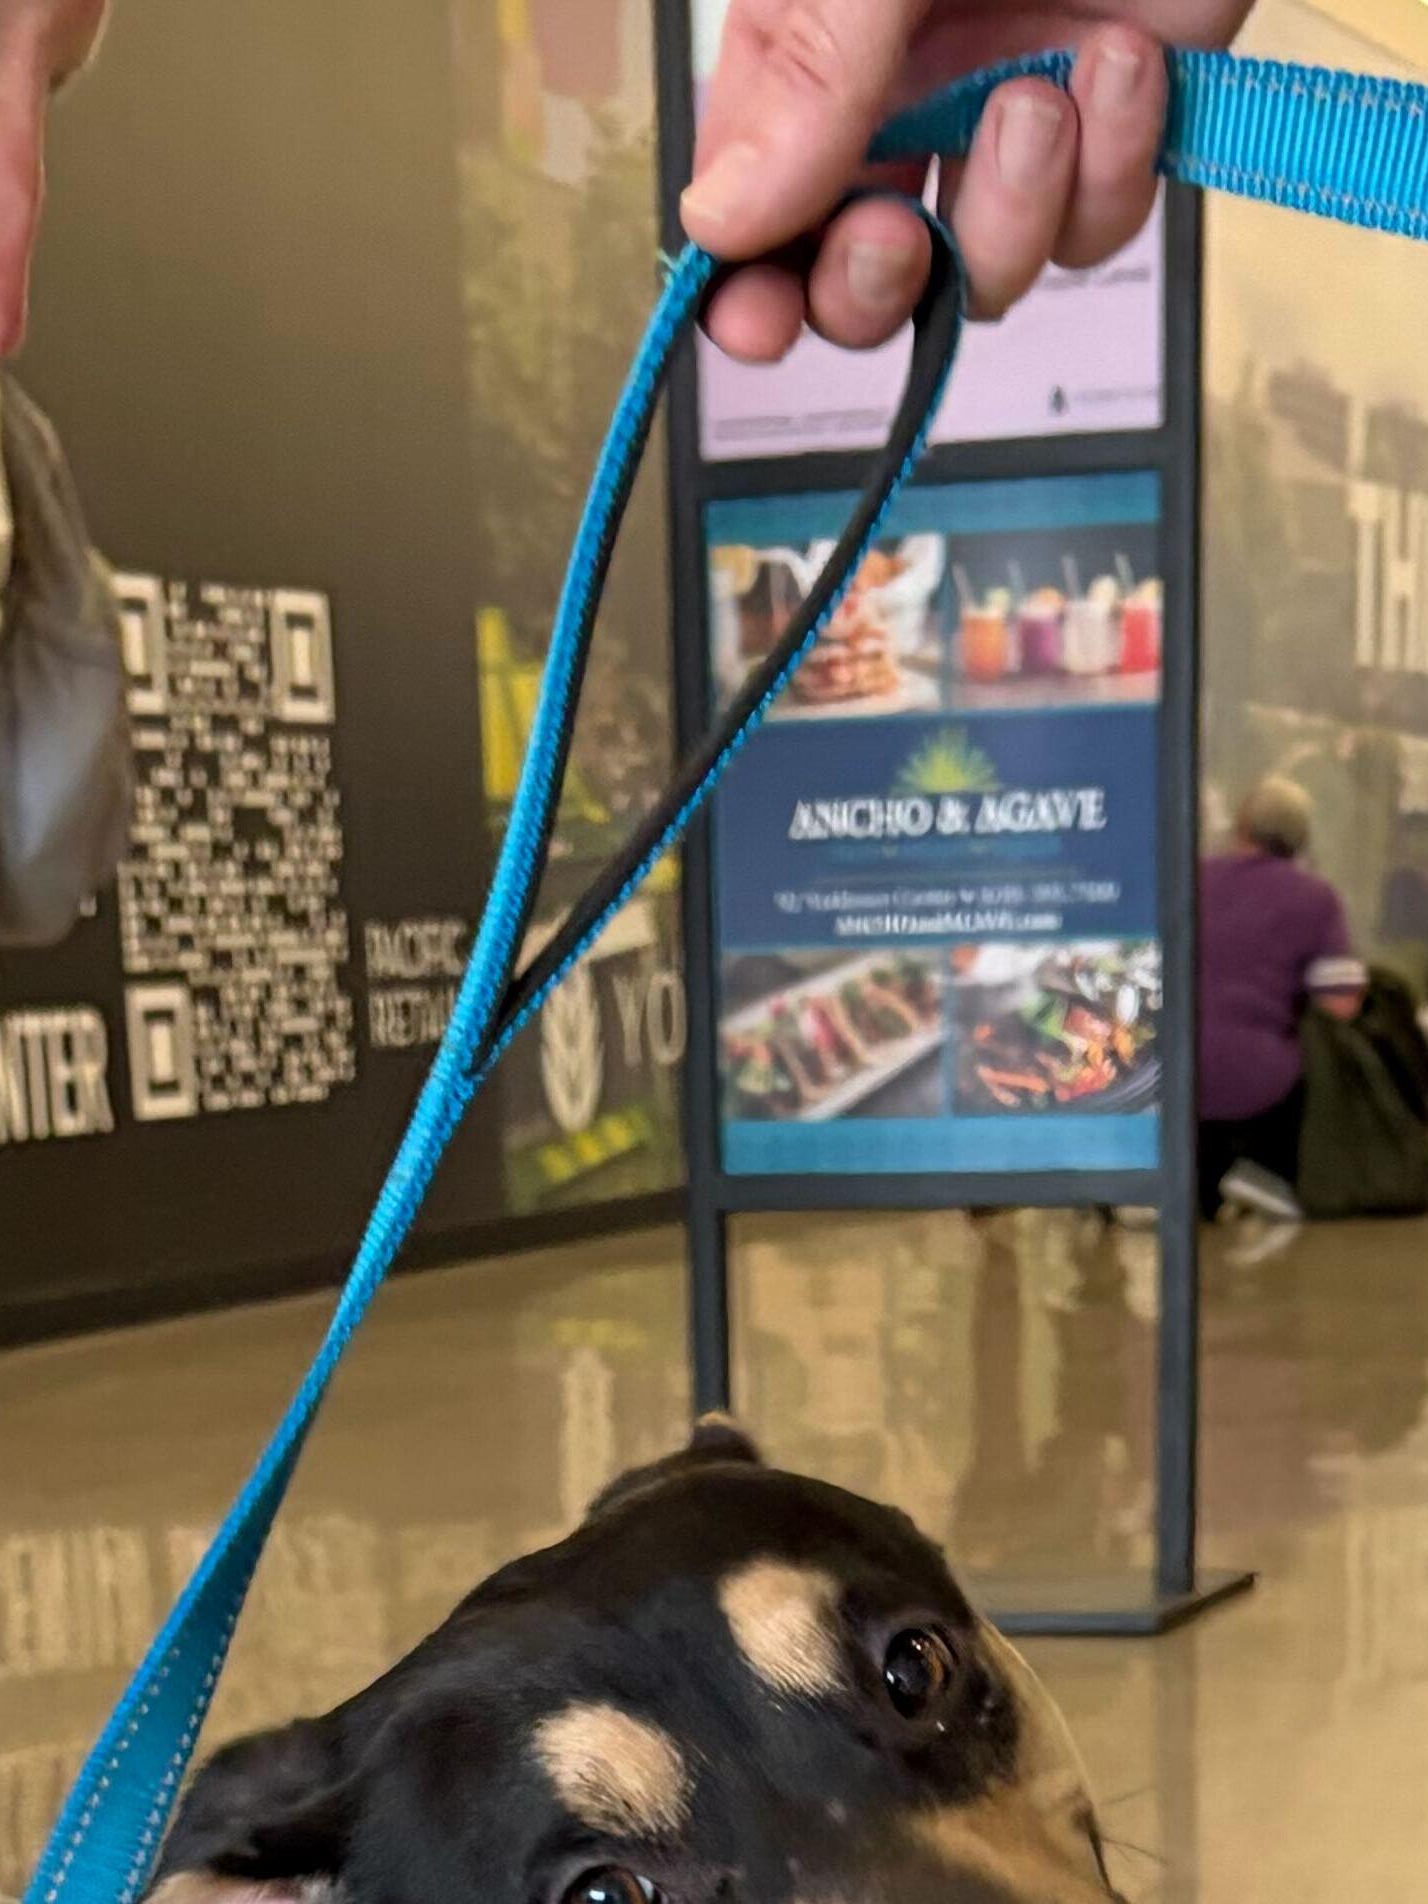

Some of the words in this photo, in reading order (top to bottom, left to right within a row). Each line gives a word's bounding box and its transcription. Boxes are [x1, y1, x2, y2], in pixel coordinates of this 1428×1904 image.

[787, 798, 934, 841] ANCHO
[935, 795, 971, 834] &
[974, 787, 1108, 834] AGAVE
